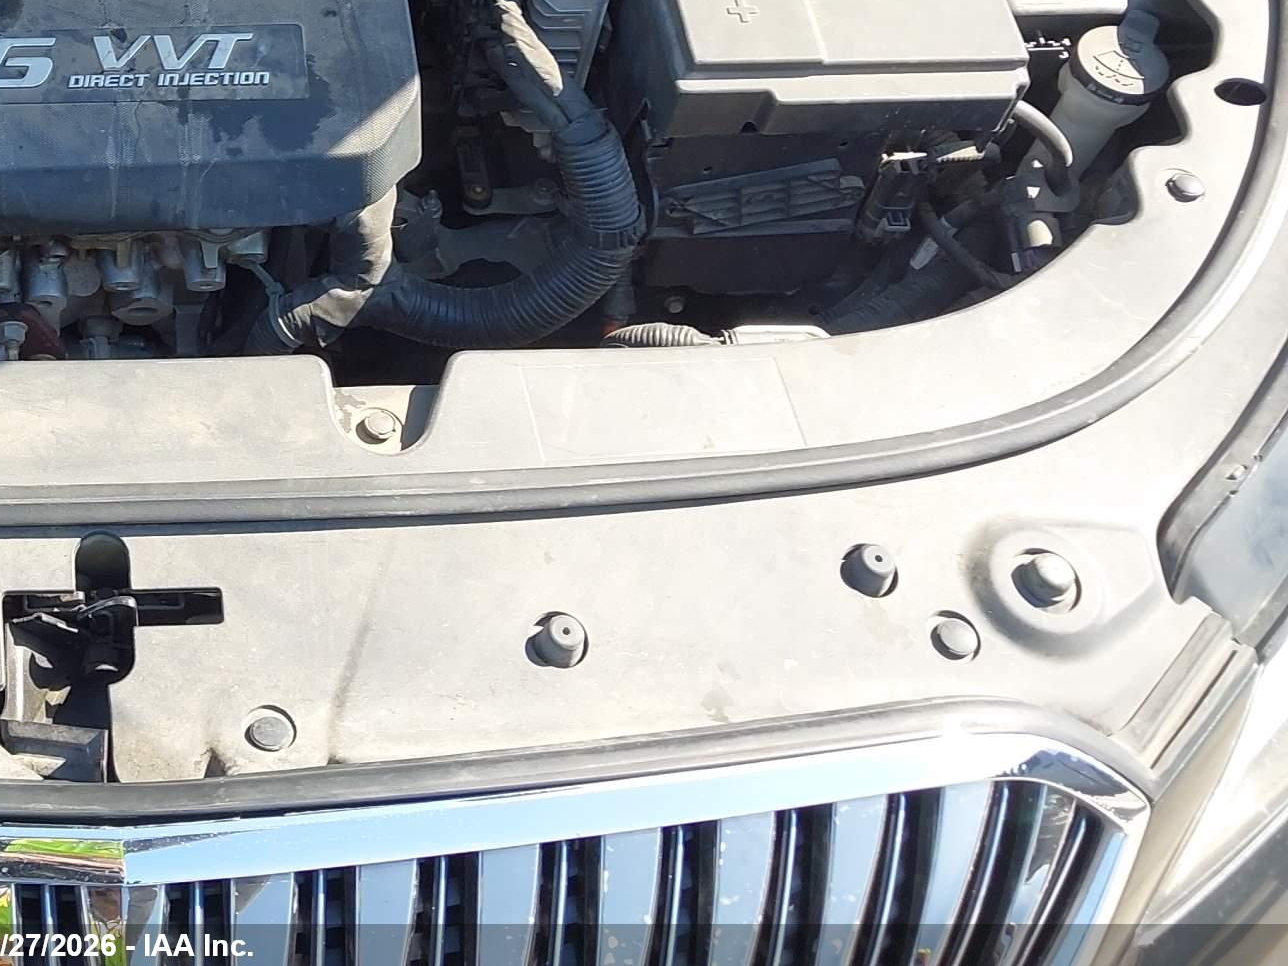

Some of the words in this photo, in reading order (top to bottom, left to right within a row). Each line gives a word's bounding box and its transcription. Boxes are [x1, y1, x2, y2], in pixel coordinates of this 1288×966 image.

[92, 32, 254, 70] VVT
[68, 74, 150, 88] DIRECT
[158, 71, 270, 87] INJECTION
